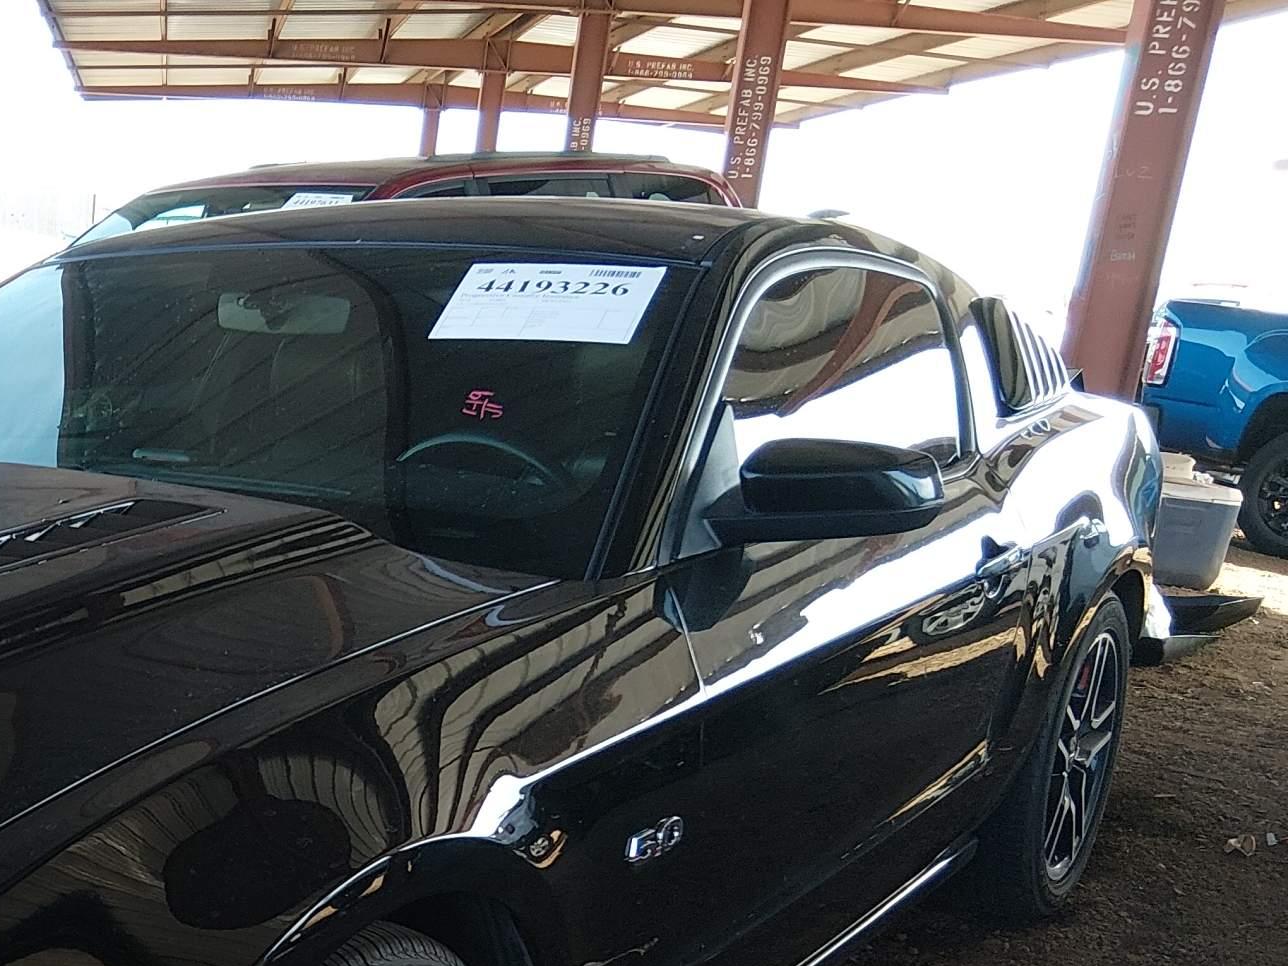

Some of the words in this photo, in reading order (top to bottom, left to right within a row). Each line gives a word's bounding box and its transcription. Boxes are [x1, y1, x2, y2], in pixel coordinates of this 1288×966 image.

[733, 89, 753, 145] PREFAB
[741, 56, 772, 178] 1-866-799-0969
[1134, 70, 1163, 116] U.S.
[477, 279, 629, 296] 44193226
